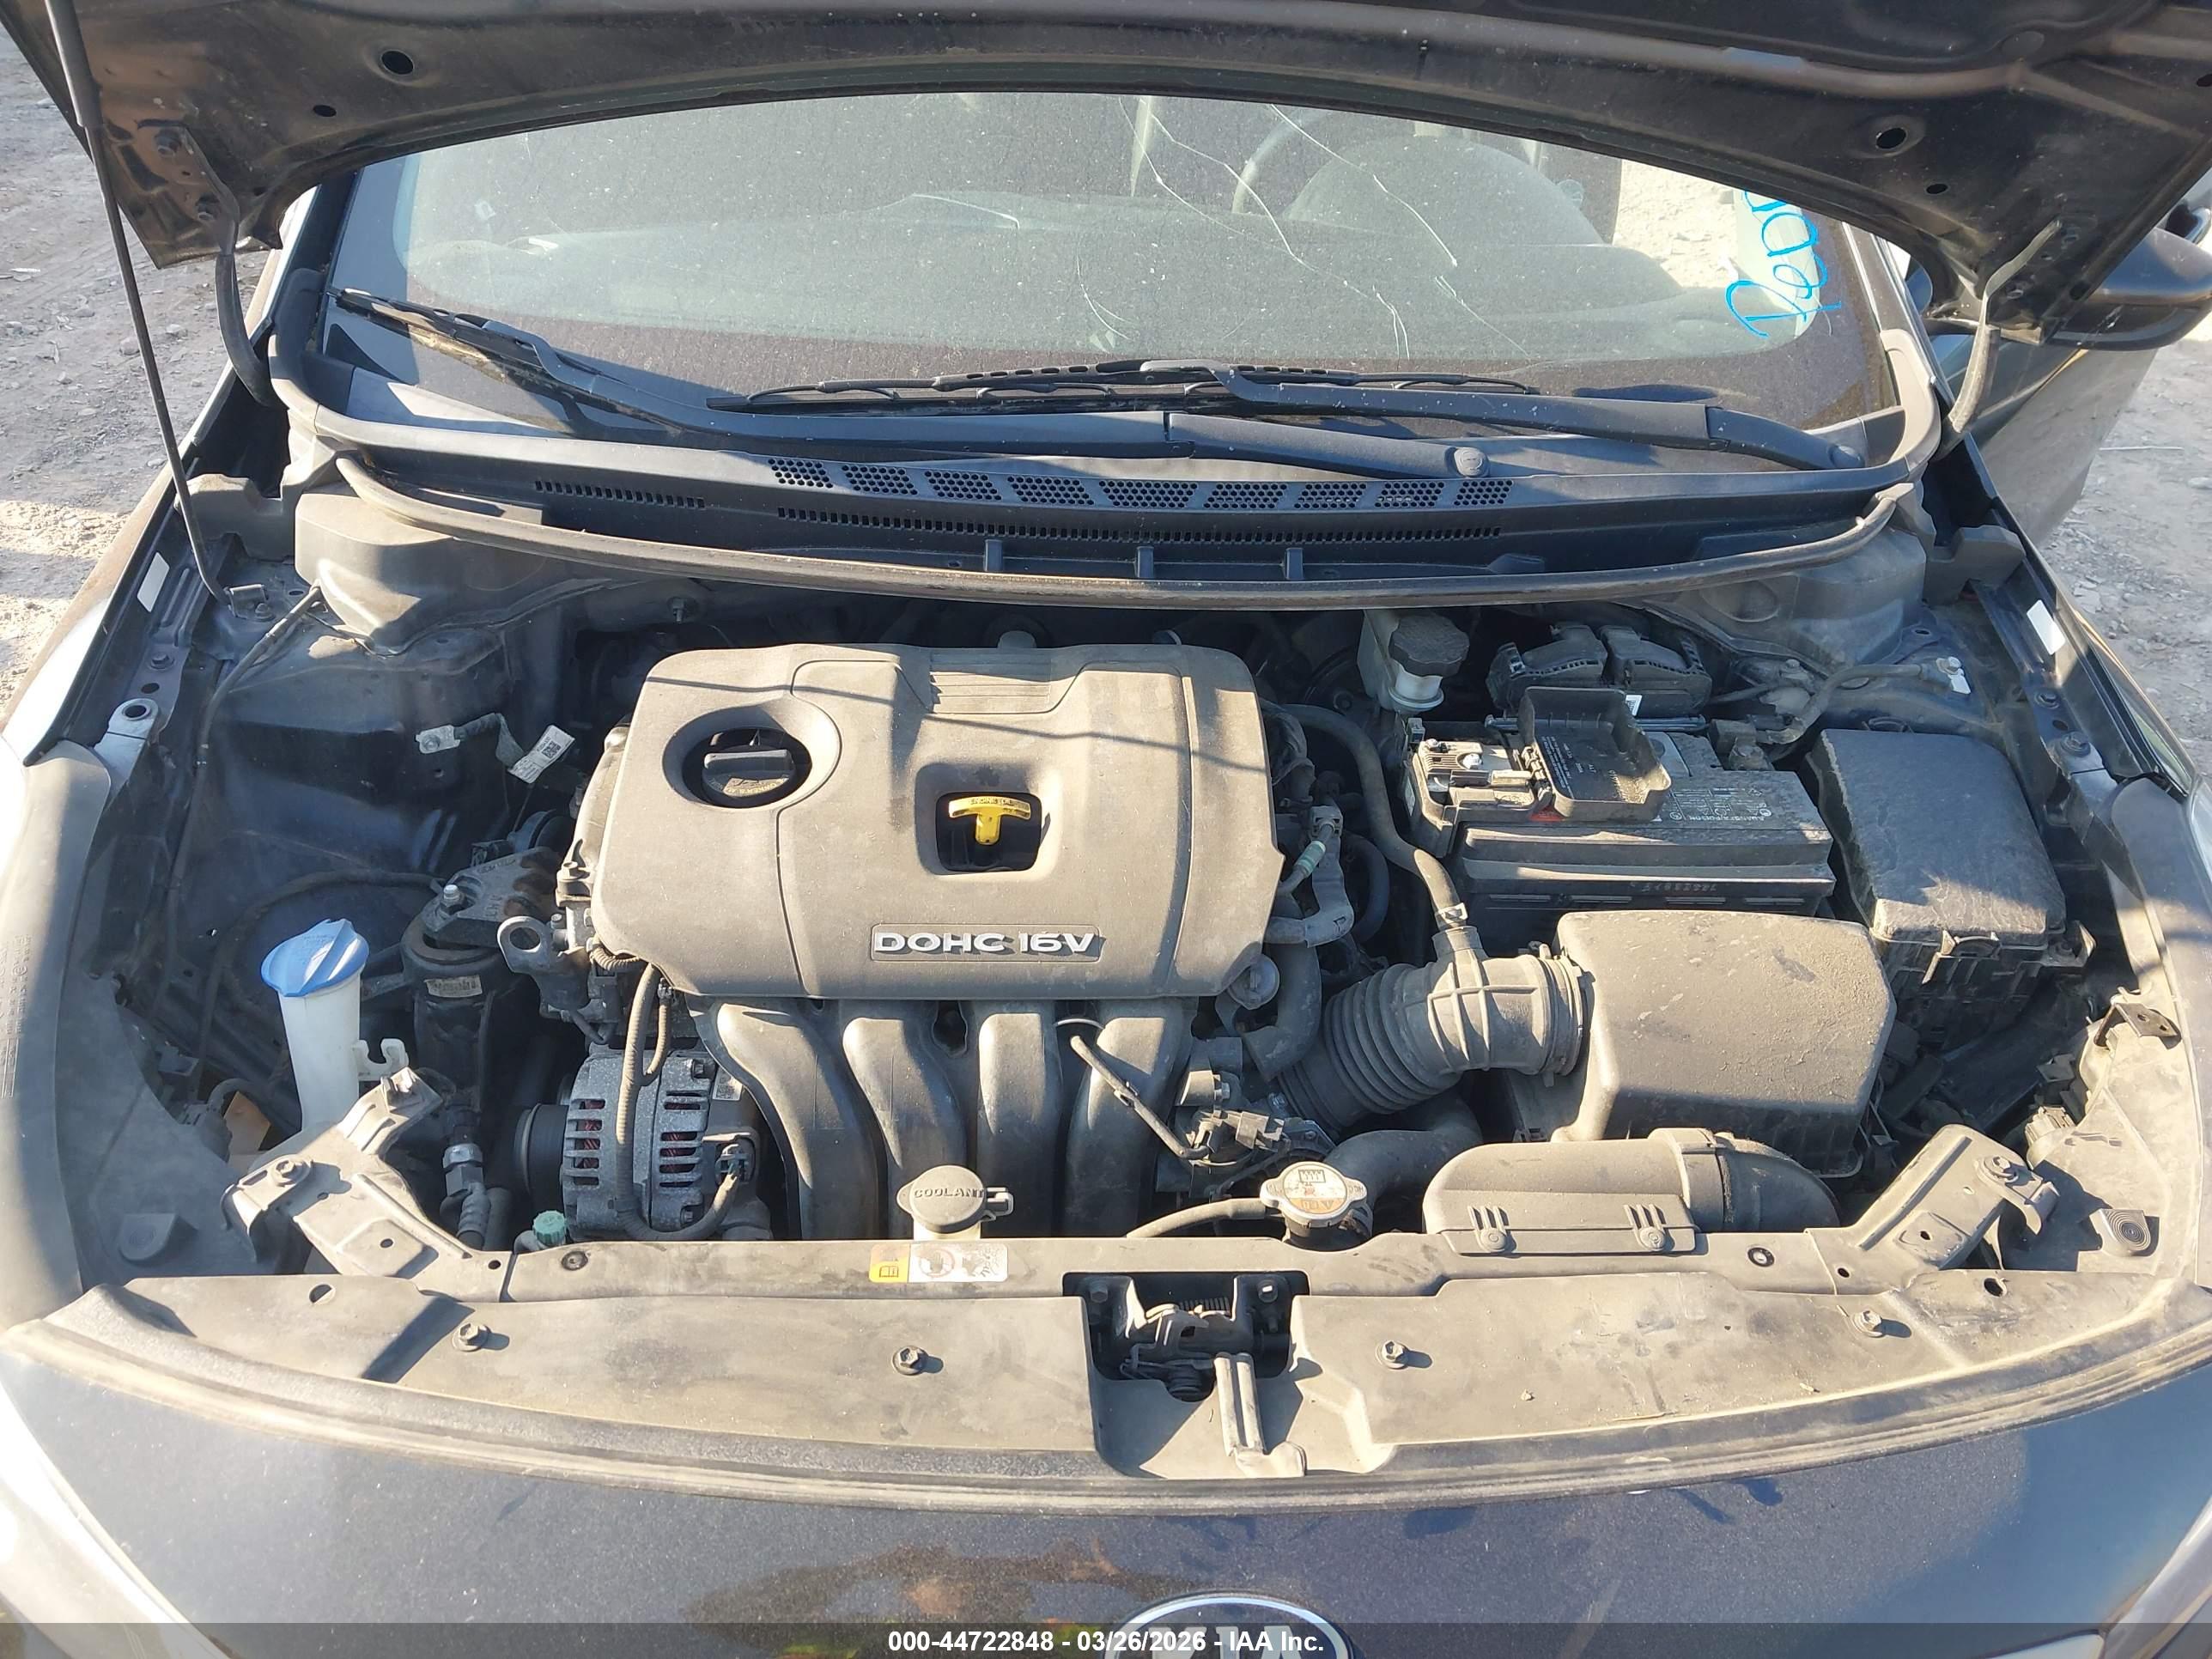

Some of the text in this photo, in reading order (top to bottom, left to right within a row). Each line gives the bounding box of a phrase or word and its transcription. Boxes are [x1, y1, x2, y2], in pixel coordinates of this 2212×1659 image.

[874, 933, 1095, 953] DOHC 16V
[914, 1188, 984, 1198] COOLANT
